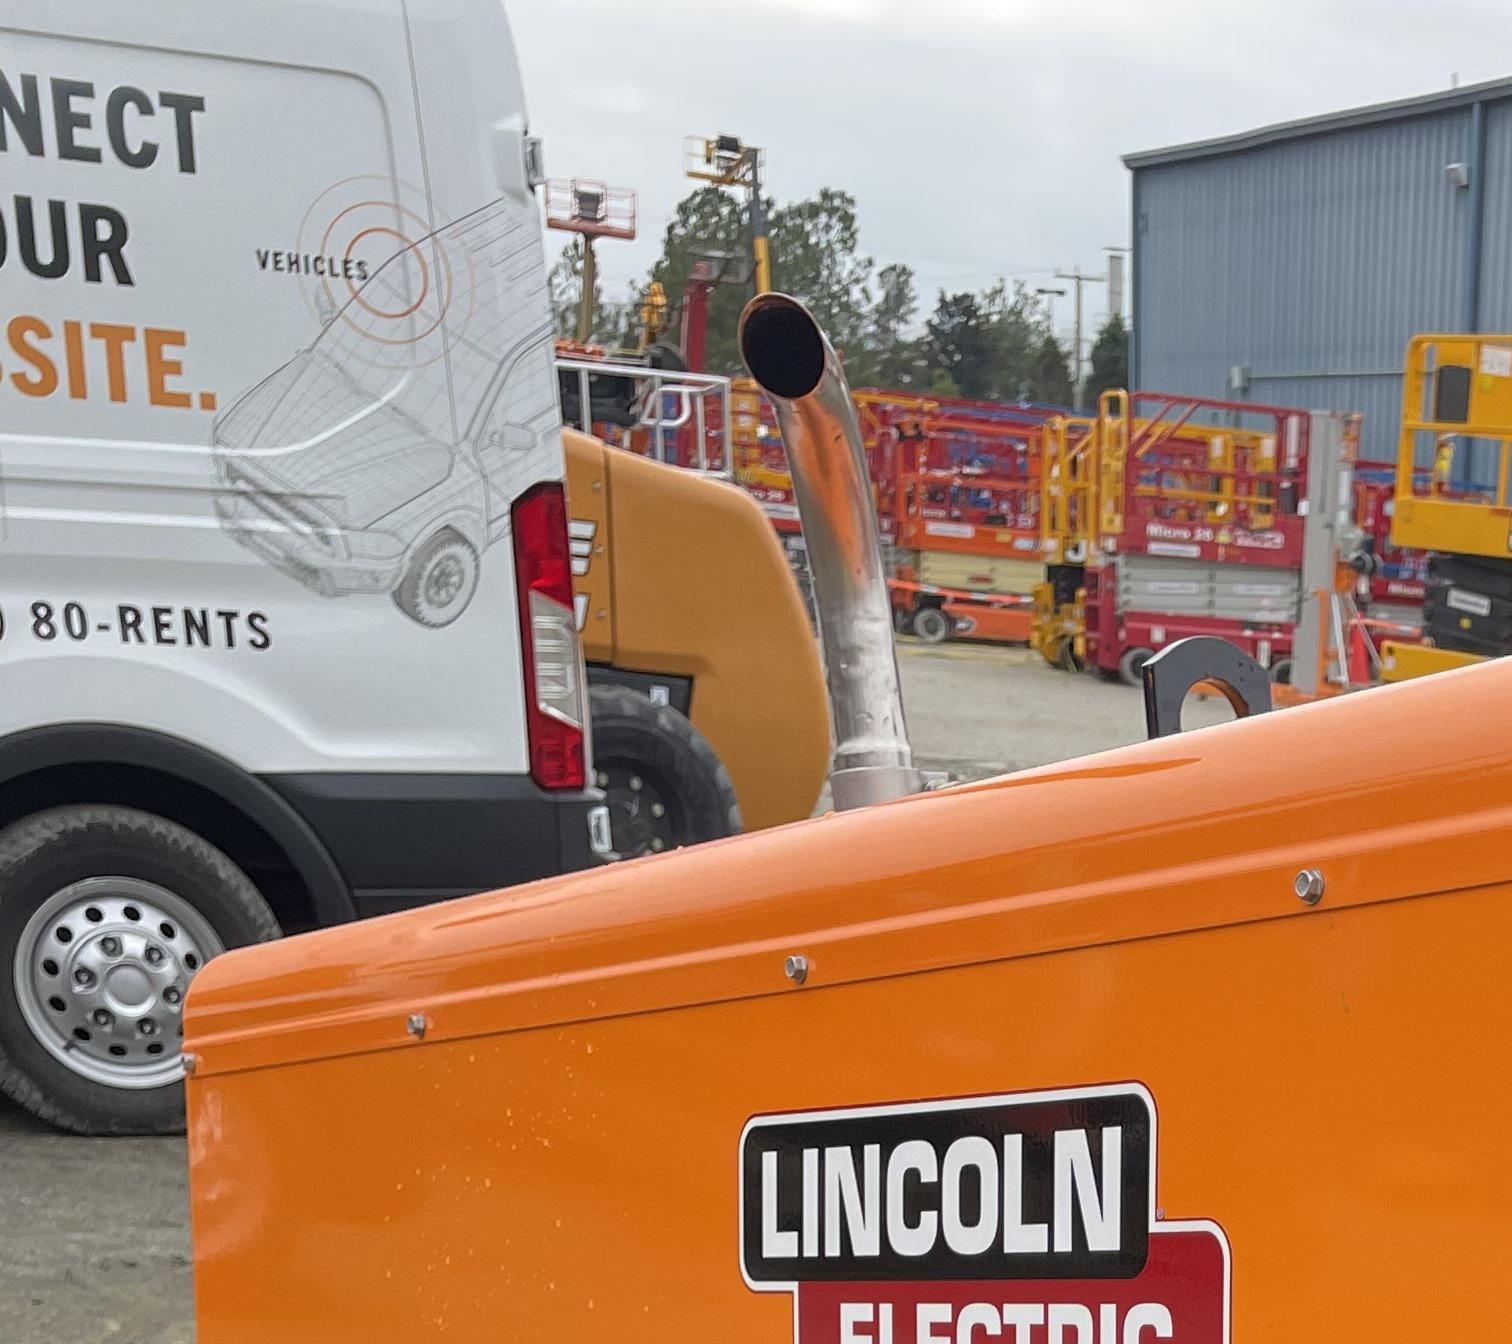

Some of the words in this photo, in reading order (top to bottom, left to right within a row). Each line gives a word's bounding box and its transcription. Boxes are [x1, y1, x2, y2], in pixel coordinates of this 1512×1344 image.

[0, 195, 135, 286] UR
[256, 249, 370, 282] VEHICLES
[0, 315, 217, 411] SITE.
[31, 602, 272, 651] 80-RENTS
[760, 1125, 1123, 1259] LINCOLN
